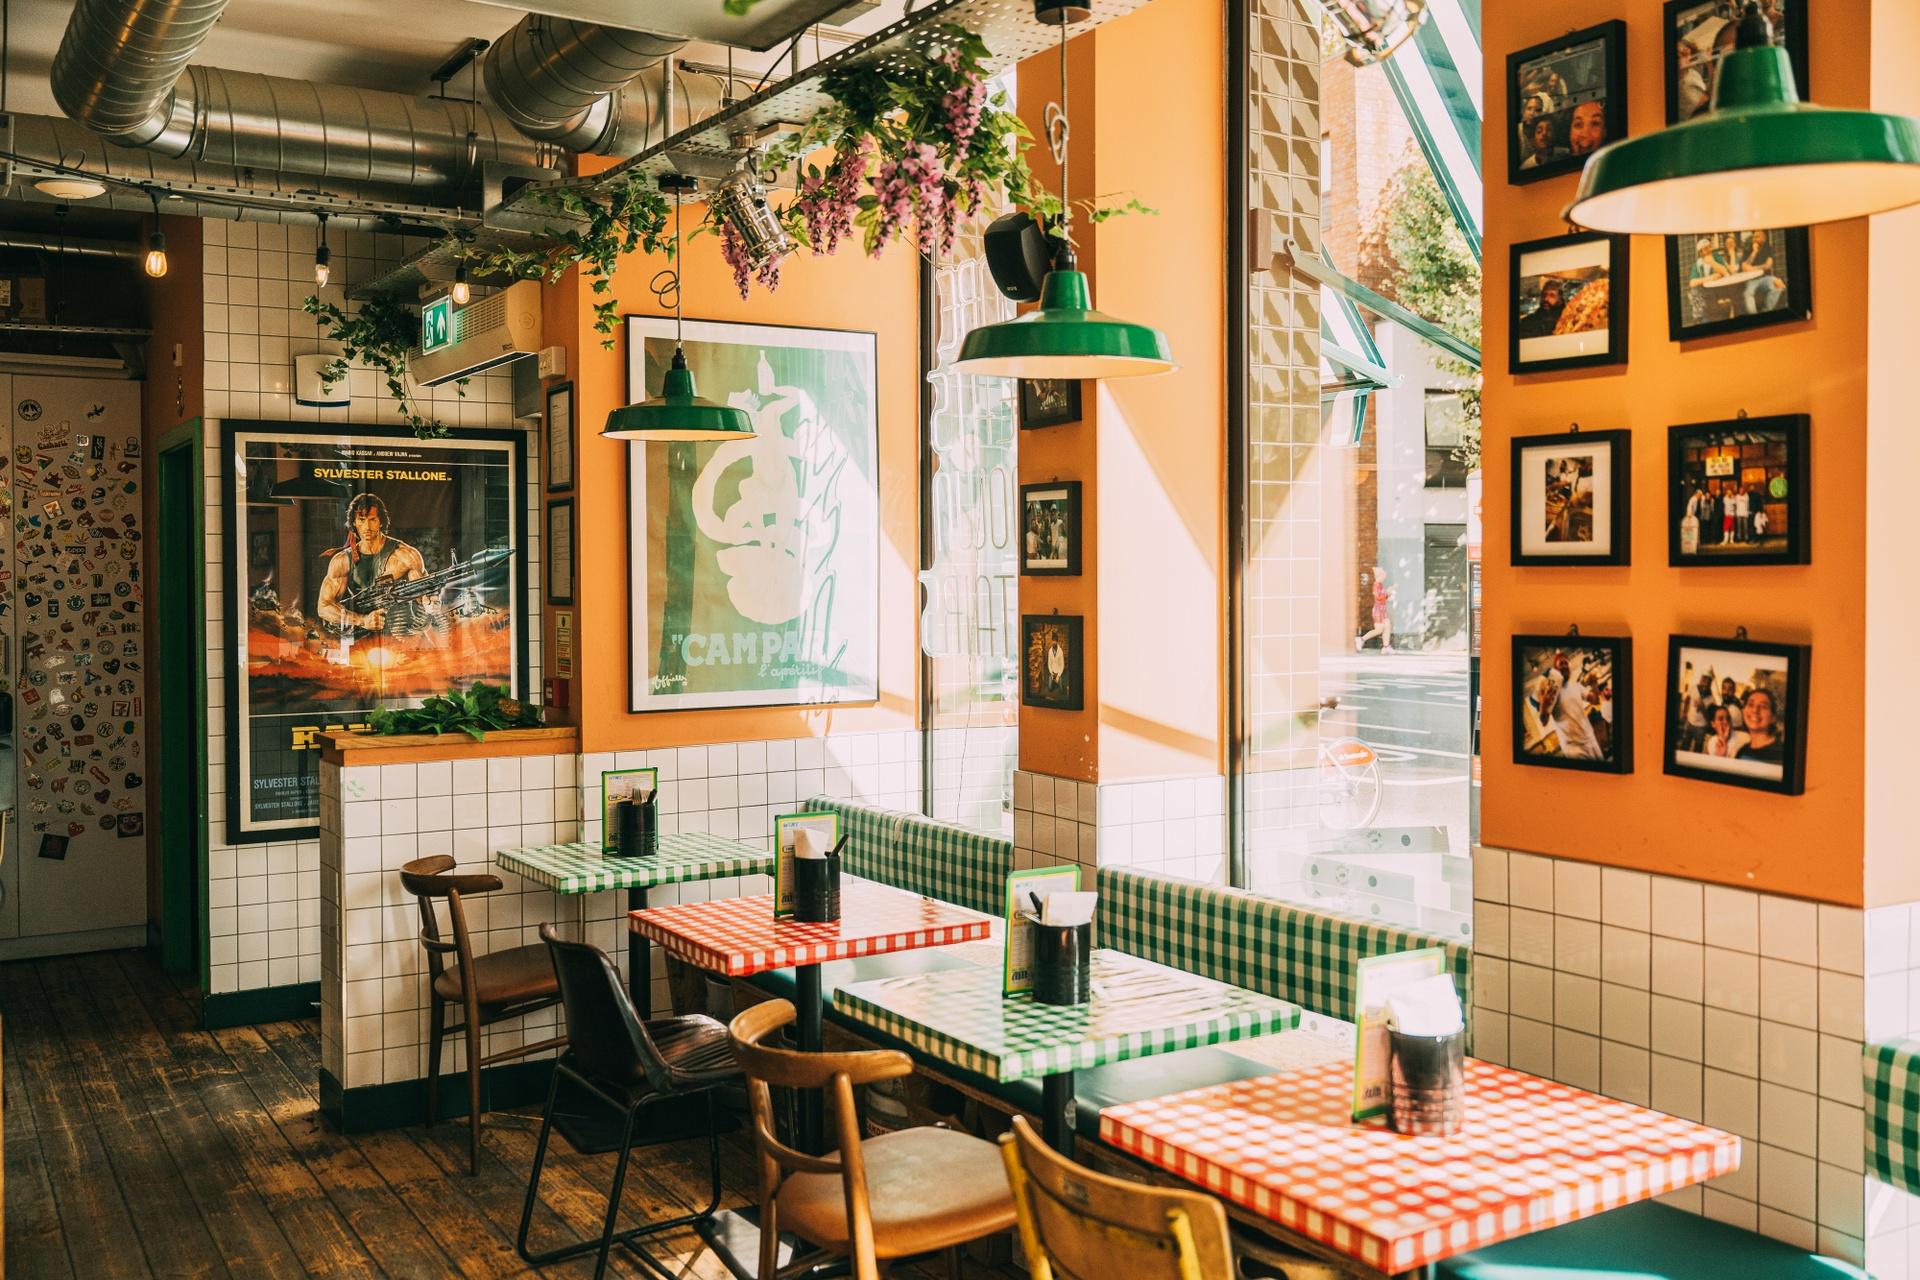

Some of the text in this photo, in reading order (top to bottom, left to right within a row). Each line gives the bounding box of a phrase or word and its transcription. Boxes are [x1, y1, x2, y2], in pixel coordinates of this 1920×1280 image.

[314, 468, 447, 481] SYLVESTER STALLONE
[253, 777, 298, 789] SYLVESTER
